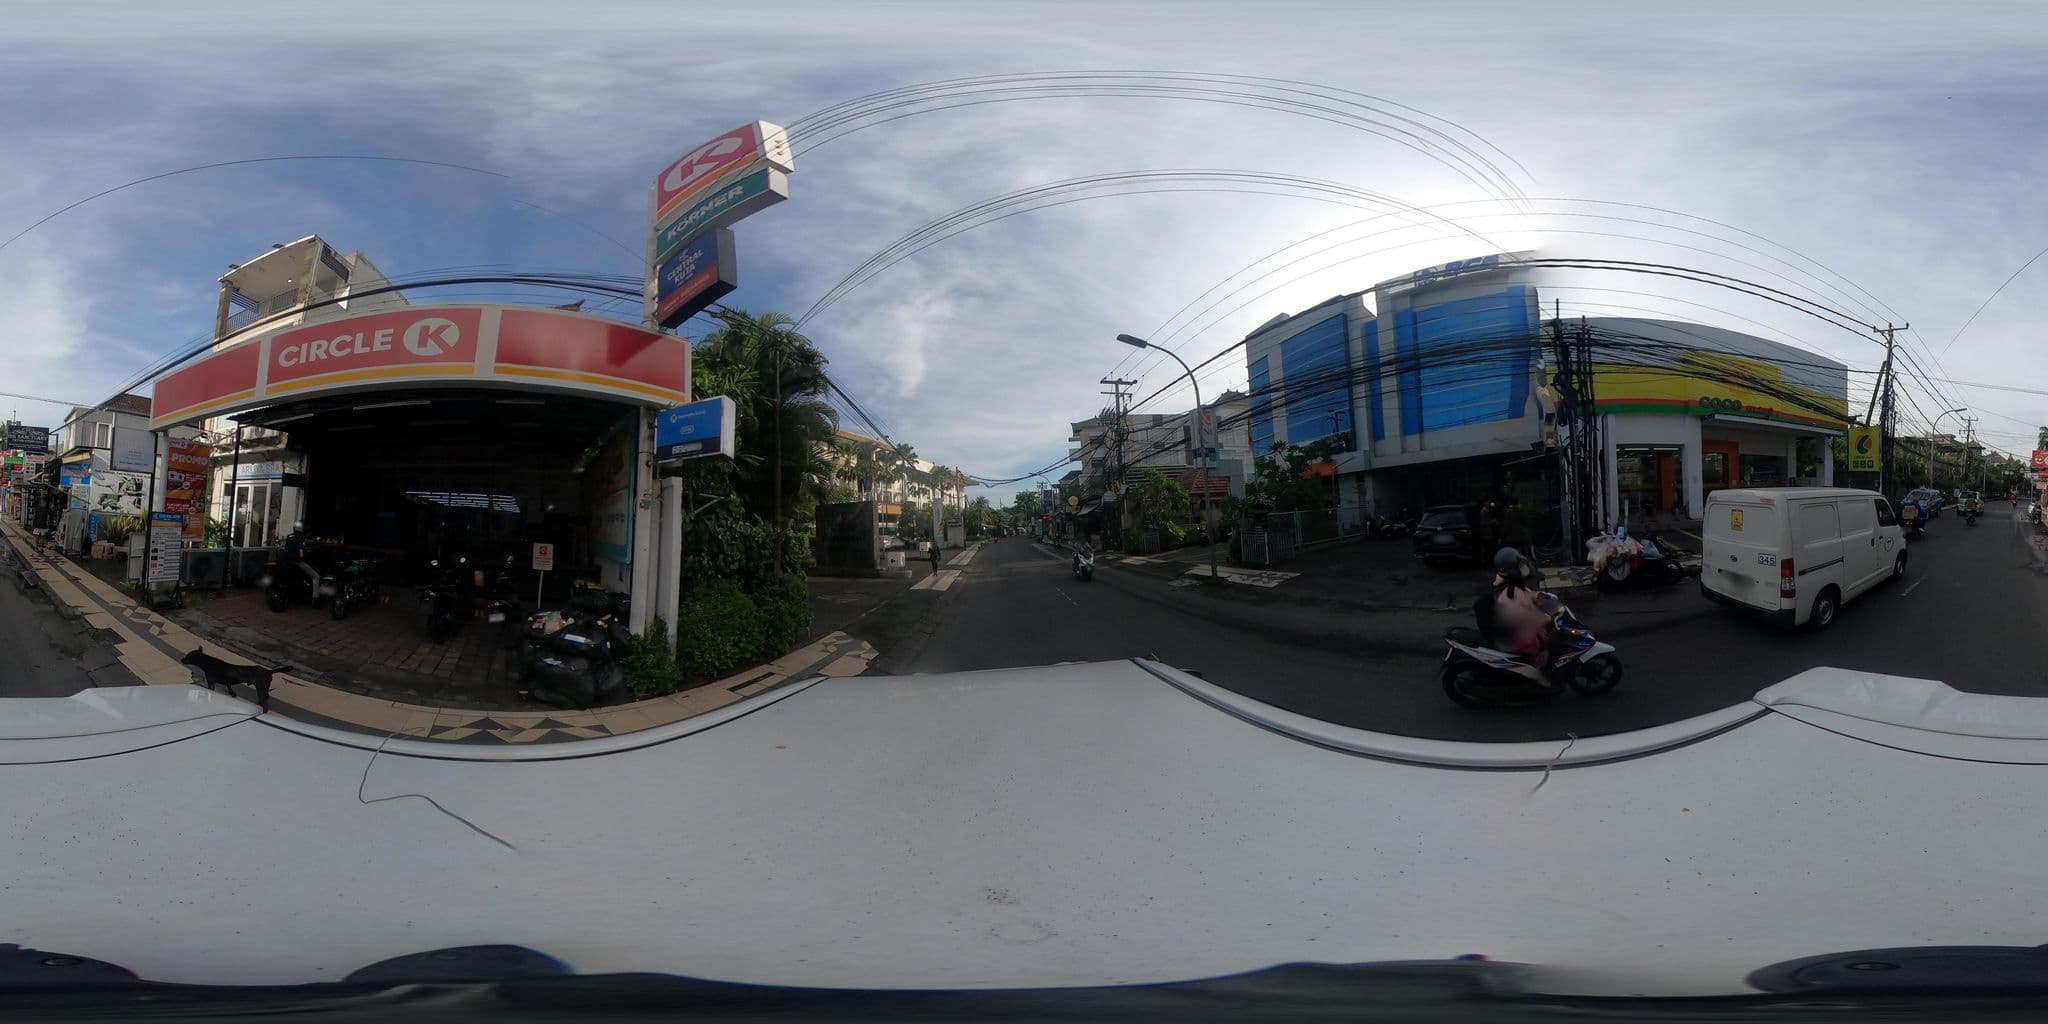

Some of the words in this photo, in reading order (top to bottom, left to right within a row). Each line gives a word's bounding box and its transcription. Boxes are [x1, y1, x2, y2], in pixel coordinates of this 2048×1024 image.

[667, 185, 744, 240] KORNER
[667, 249, 704, 280] CENTRAL
[278, 328, 394, 367] CIRCLE
[172, 452, 208, 466] PROMO
[1759, 555, 1776, 566] 345
